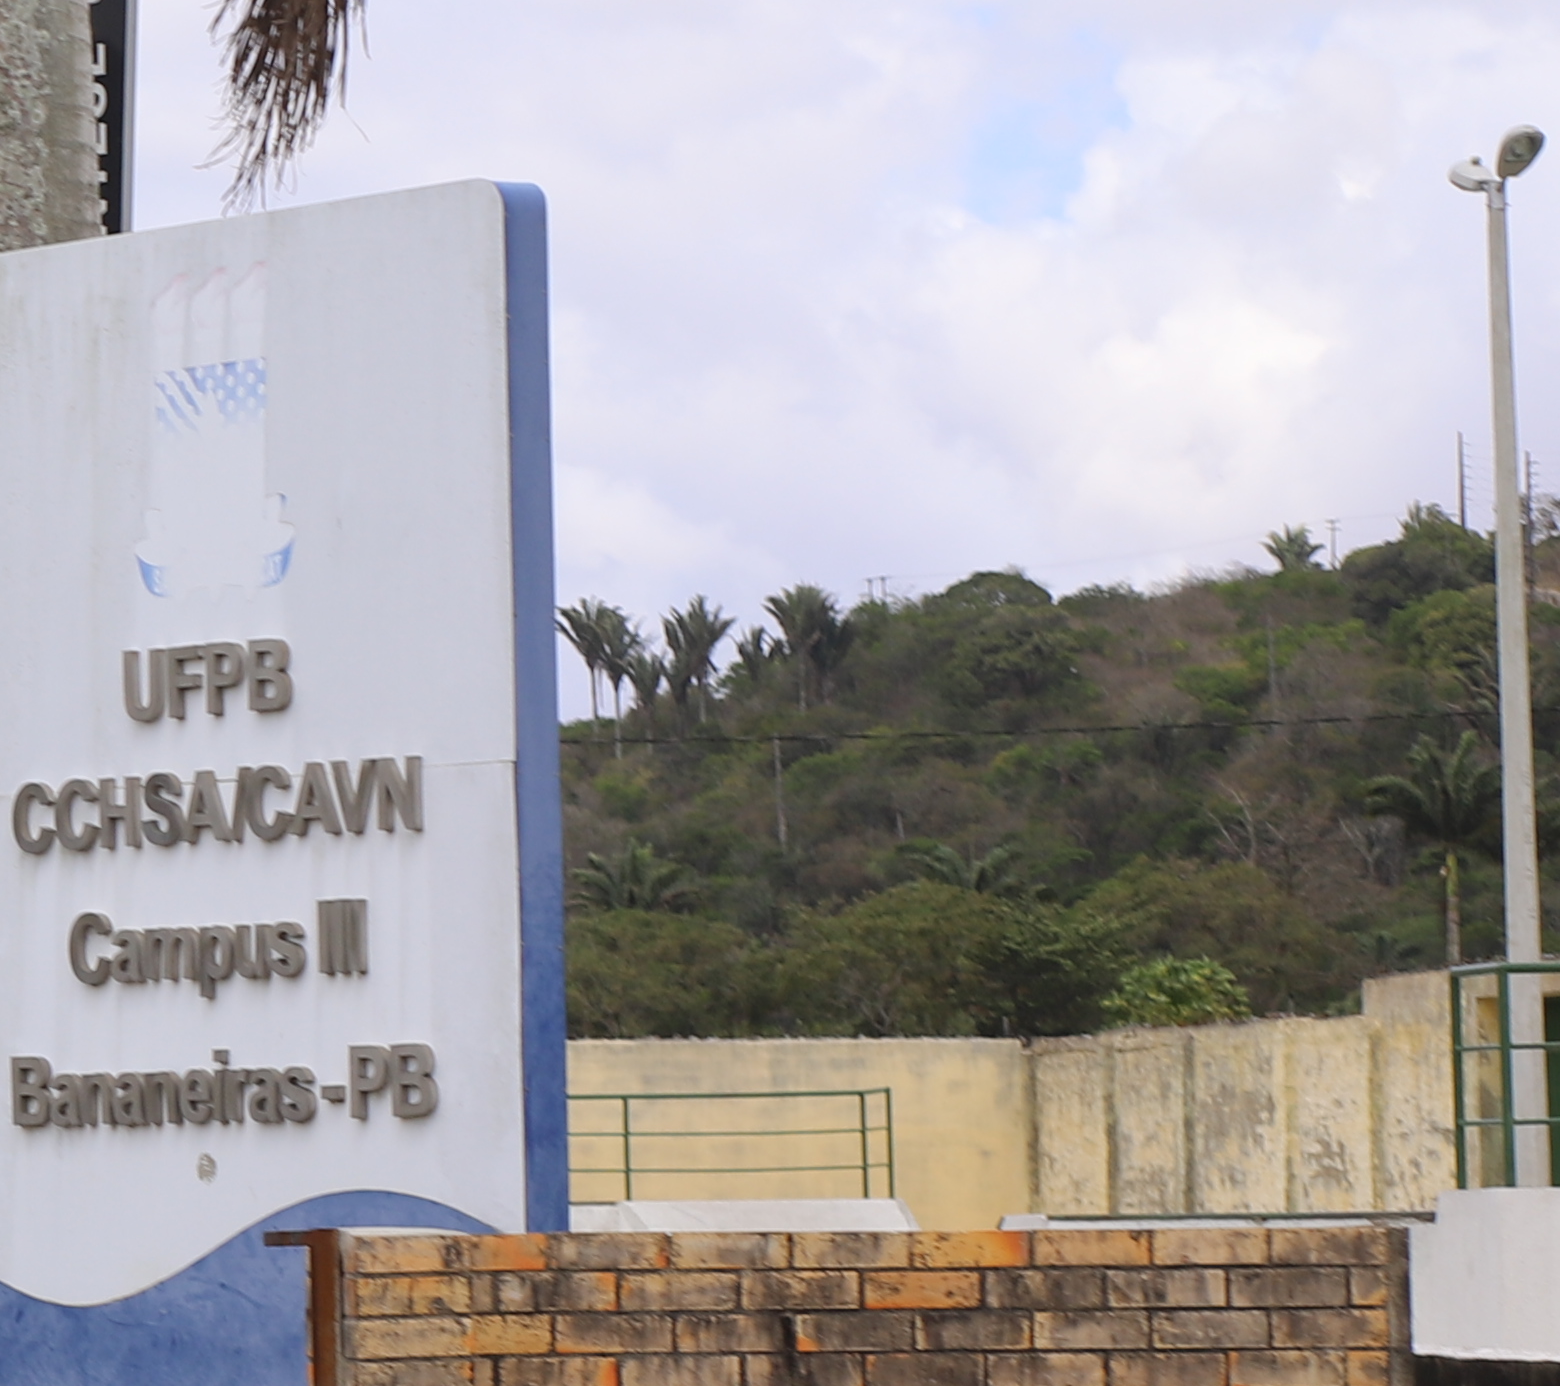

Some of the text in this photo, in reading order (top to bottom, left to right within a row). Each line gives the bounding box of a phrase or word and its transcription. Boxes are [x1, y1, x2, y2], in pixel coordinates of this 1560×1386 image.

[122, 638, 293, 723] UFPB
[11, 755, 424, 855] CCHSA/CAVN
[68, 898, 369, 1000] Campus III
